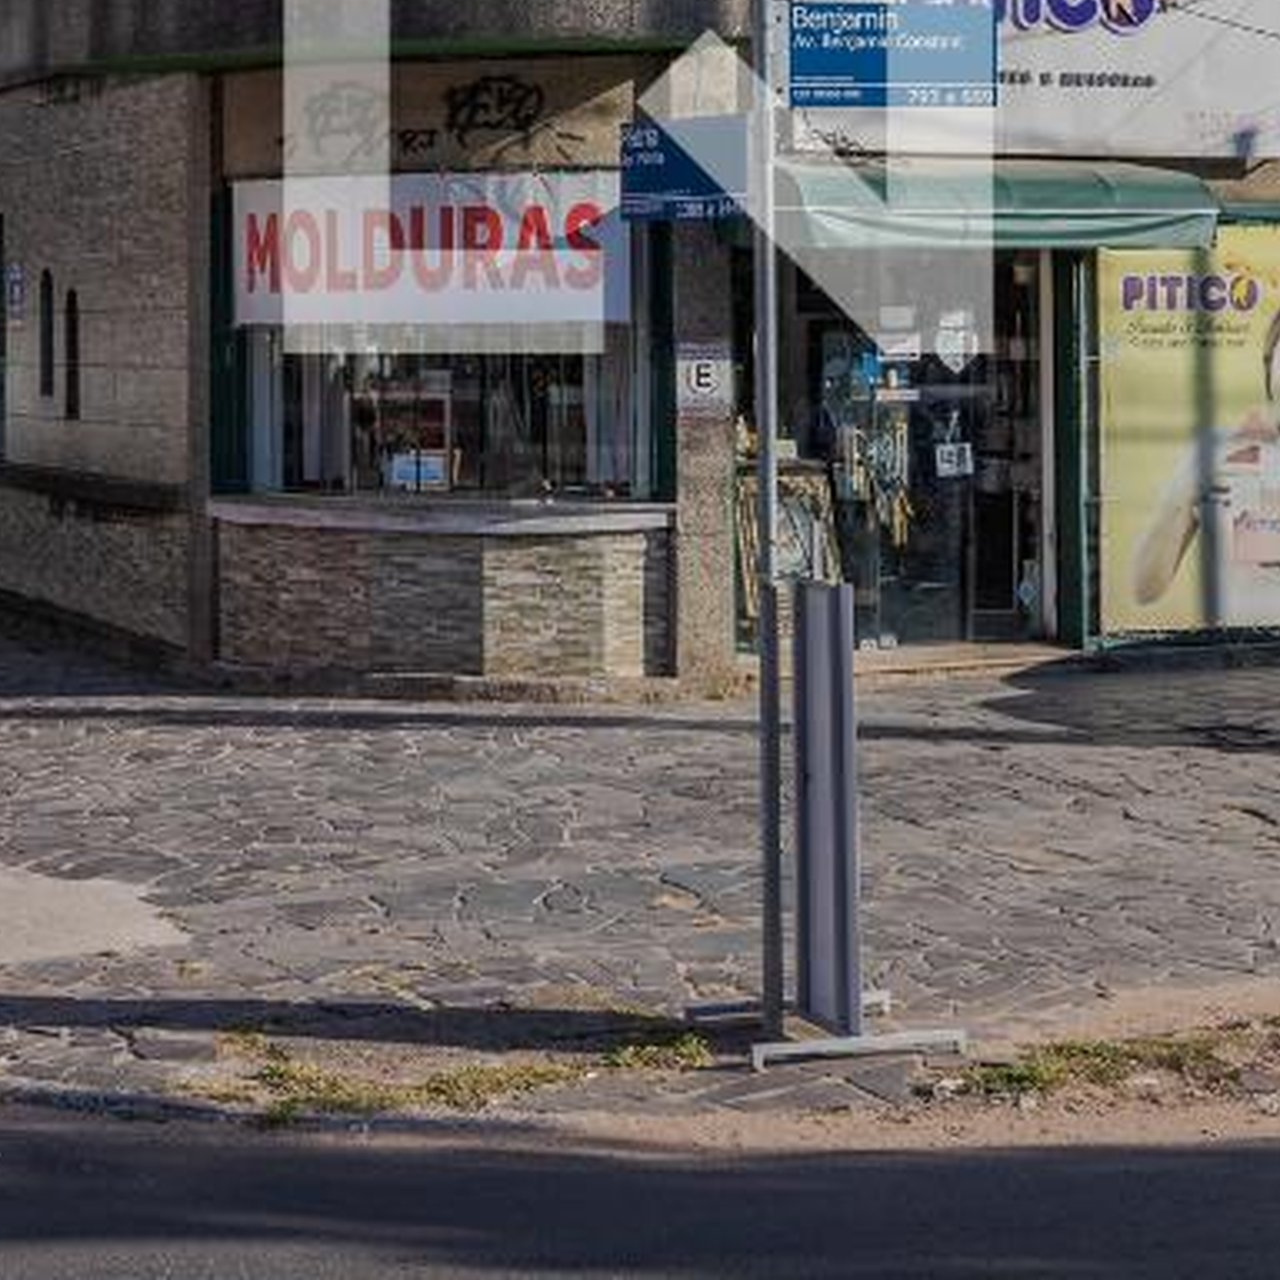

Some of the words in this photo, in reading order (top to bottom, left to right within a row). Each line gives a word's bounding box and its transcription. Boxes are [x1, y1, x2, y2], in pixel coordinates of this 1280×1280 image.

[792, 6, 899, 34] Benjamin
[245, 202, 604, 295] MOLDURAS
[1122, 274, 1260, 312] PITICO
[695, 363, 712, 388] E
